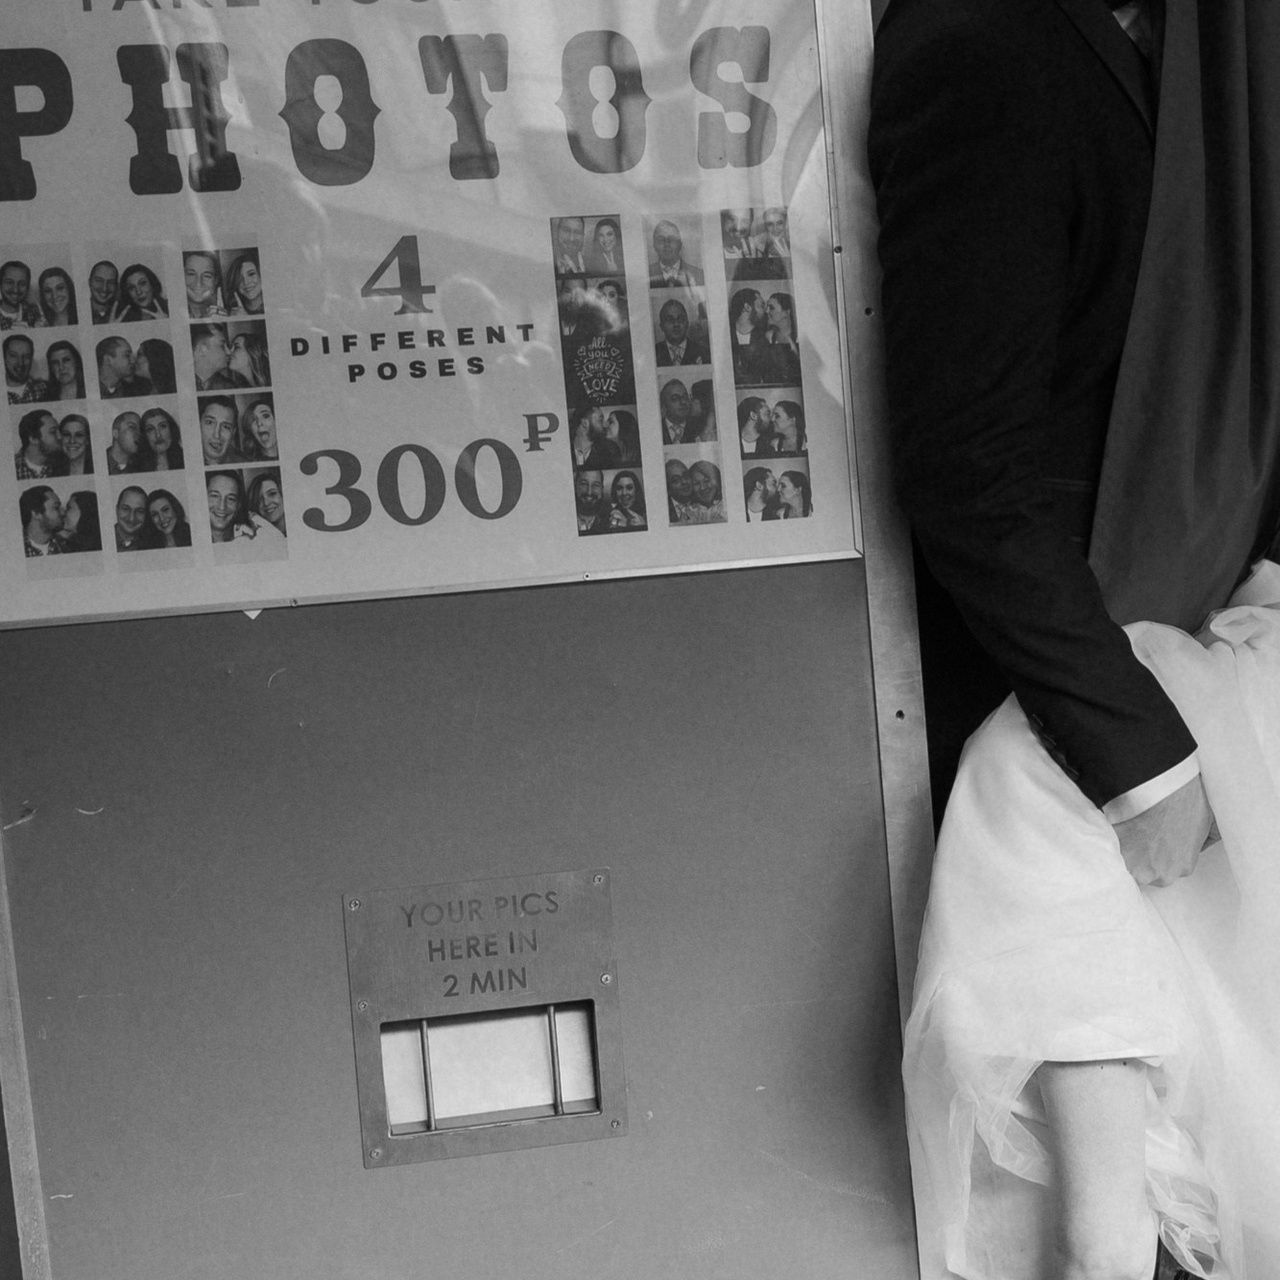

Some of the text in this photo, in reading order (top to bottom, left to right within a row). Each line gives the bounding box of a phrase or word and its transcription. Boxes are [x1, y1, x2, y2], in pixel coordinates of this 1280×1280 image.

[0, 26, 778, 201] PHOTOS
[360, 234, 437, 316] 4
[290, 323, 535, 357] DIFFERENT
[347, 356, 486, 383] POSES
[583, 378, 619, 394] LOVE
[401, 891, 560, 928] YOUR PICS
[428, 928, 538, 962] HERE IN
[443, 966, 528, 998] 2 MIN
